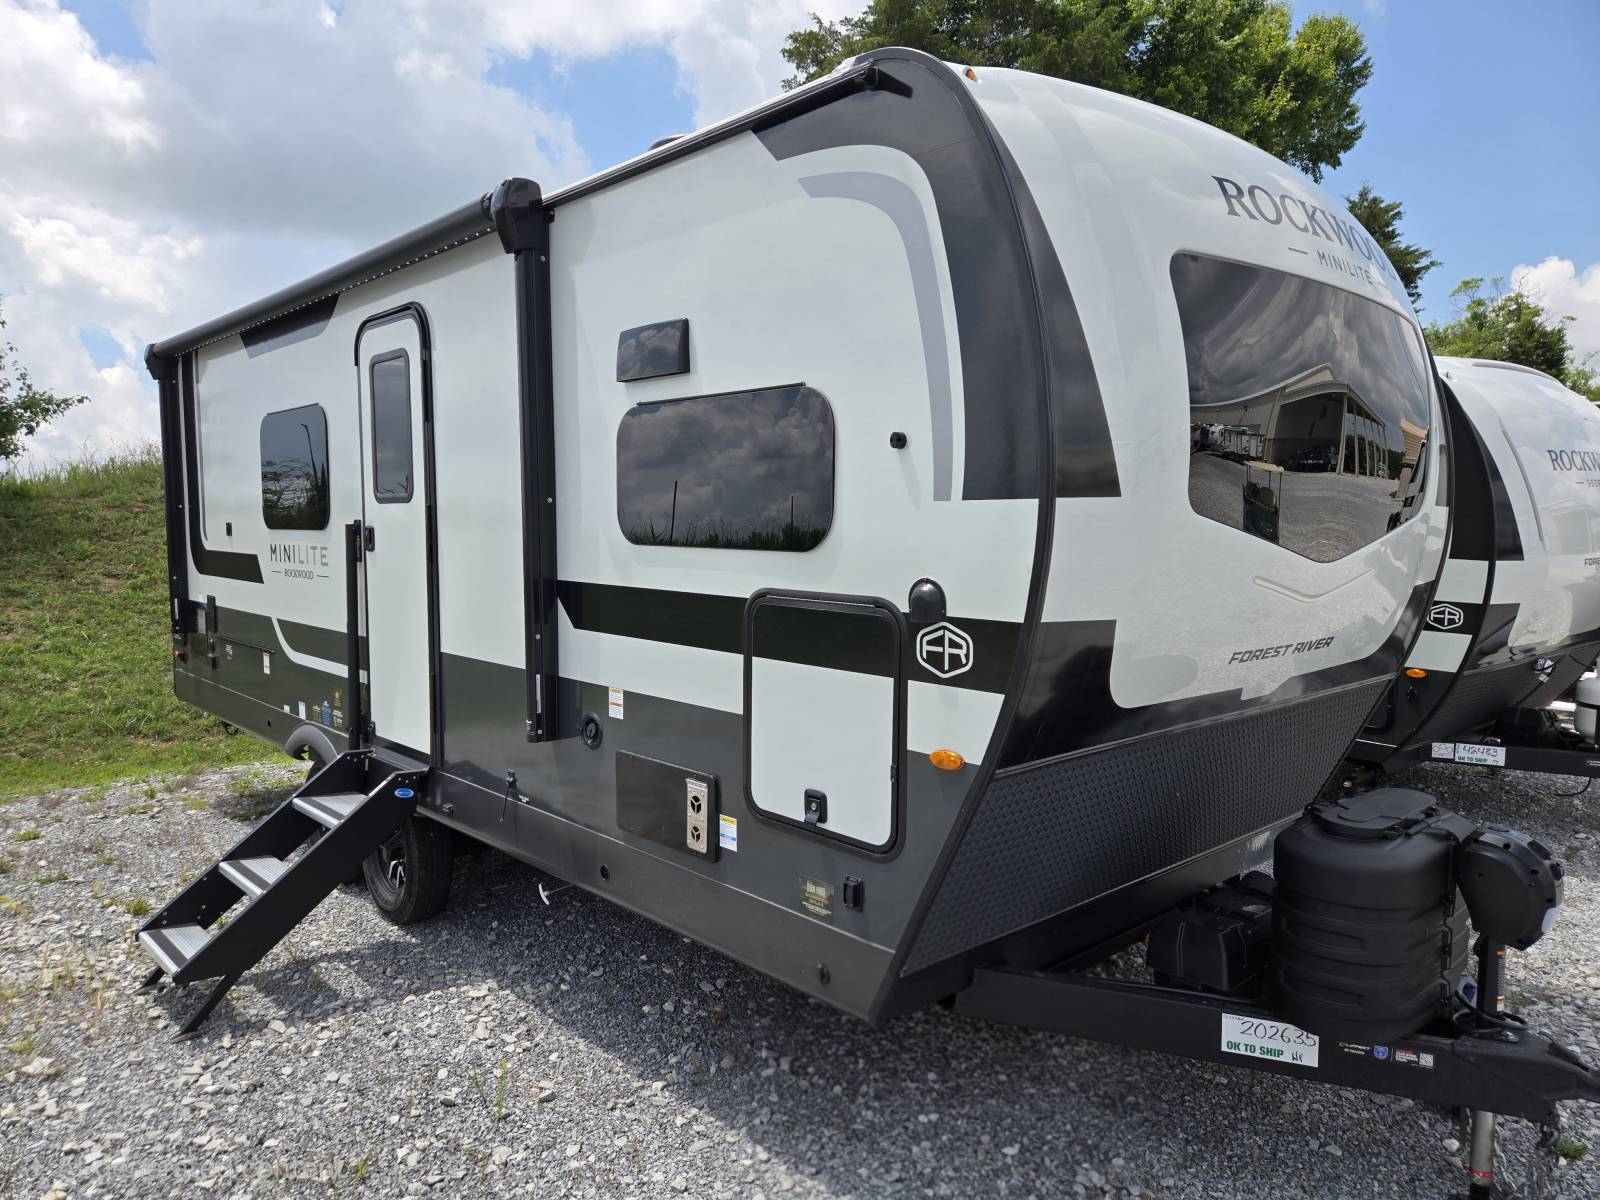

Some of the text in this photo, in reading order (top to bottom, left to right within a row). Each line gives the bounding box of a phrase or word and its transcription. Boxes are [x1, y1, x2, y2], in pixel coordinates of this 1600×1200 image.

[1316, 249, 1374, 285] MINILITE
[269, 543, 329, 567] MINILITE
[284, 568, 314, 580] ROCKWOOD
[1227, 635, 1336, 665] FOREST RIVER
[1240, 1020, 1317, 1047] 202635
[1226, 1040, 1284, 1058] OK TO SHIP
